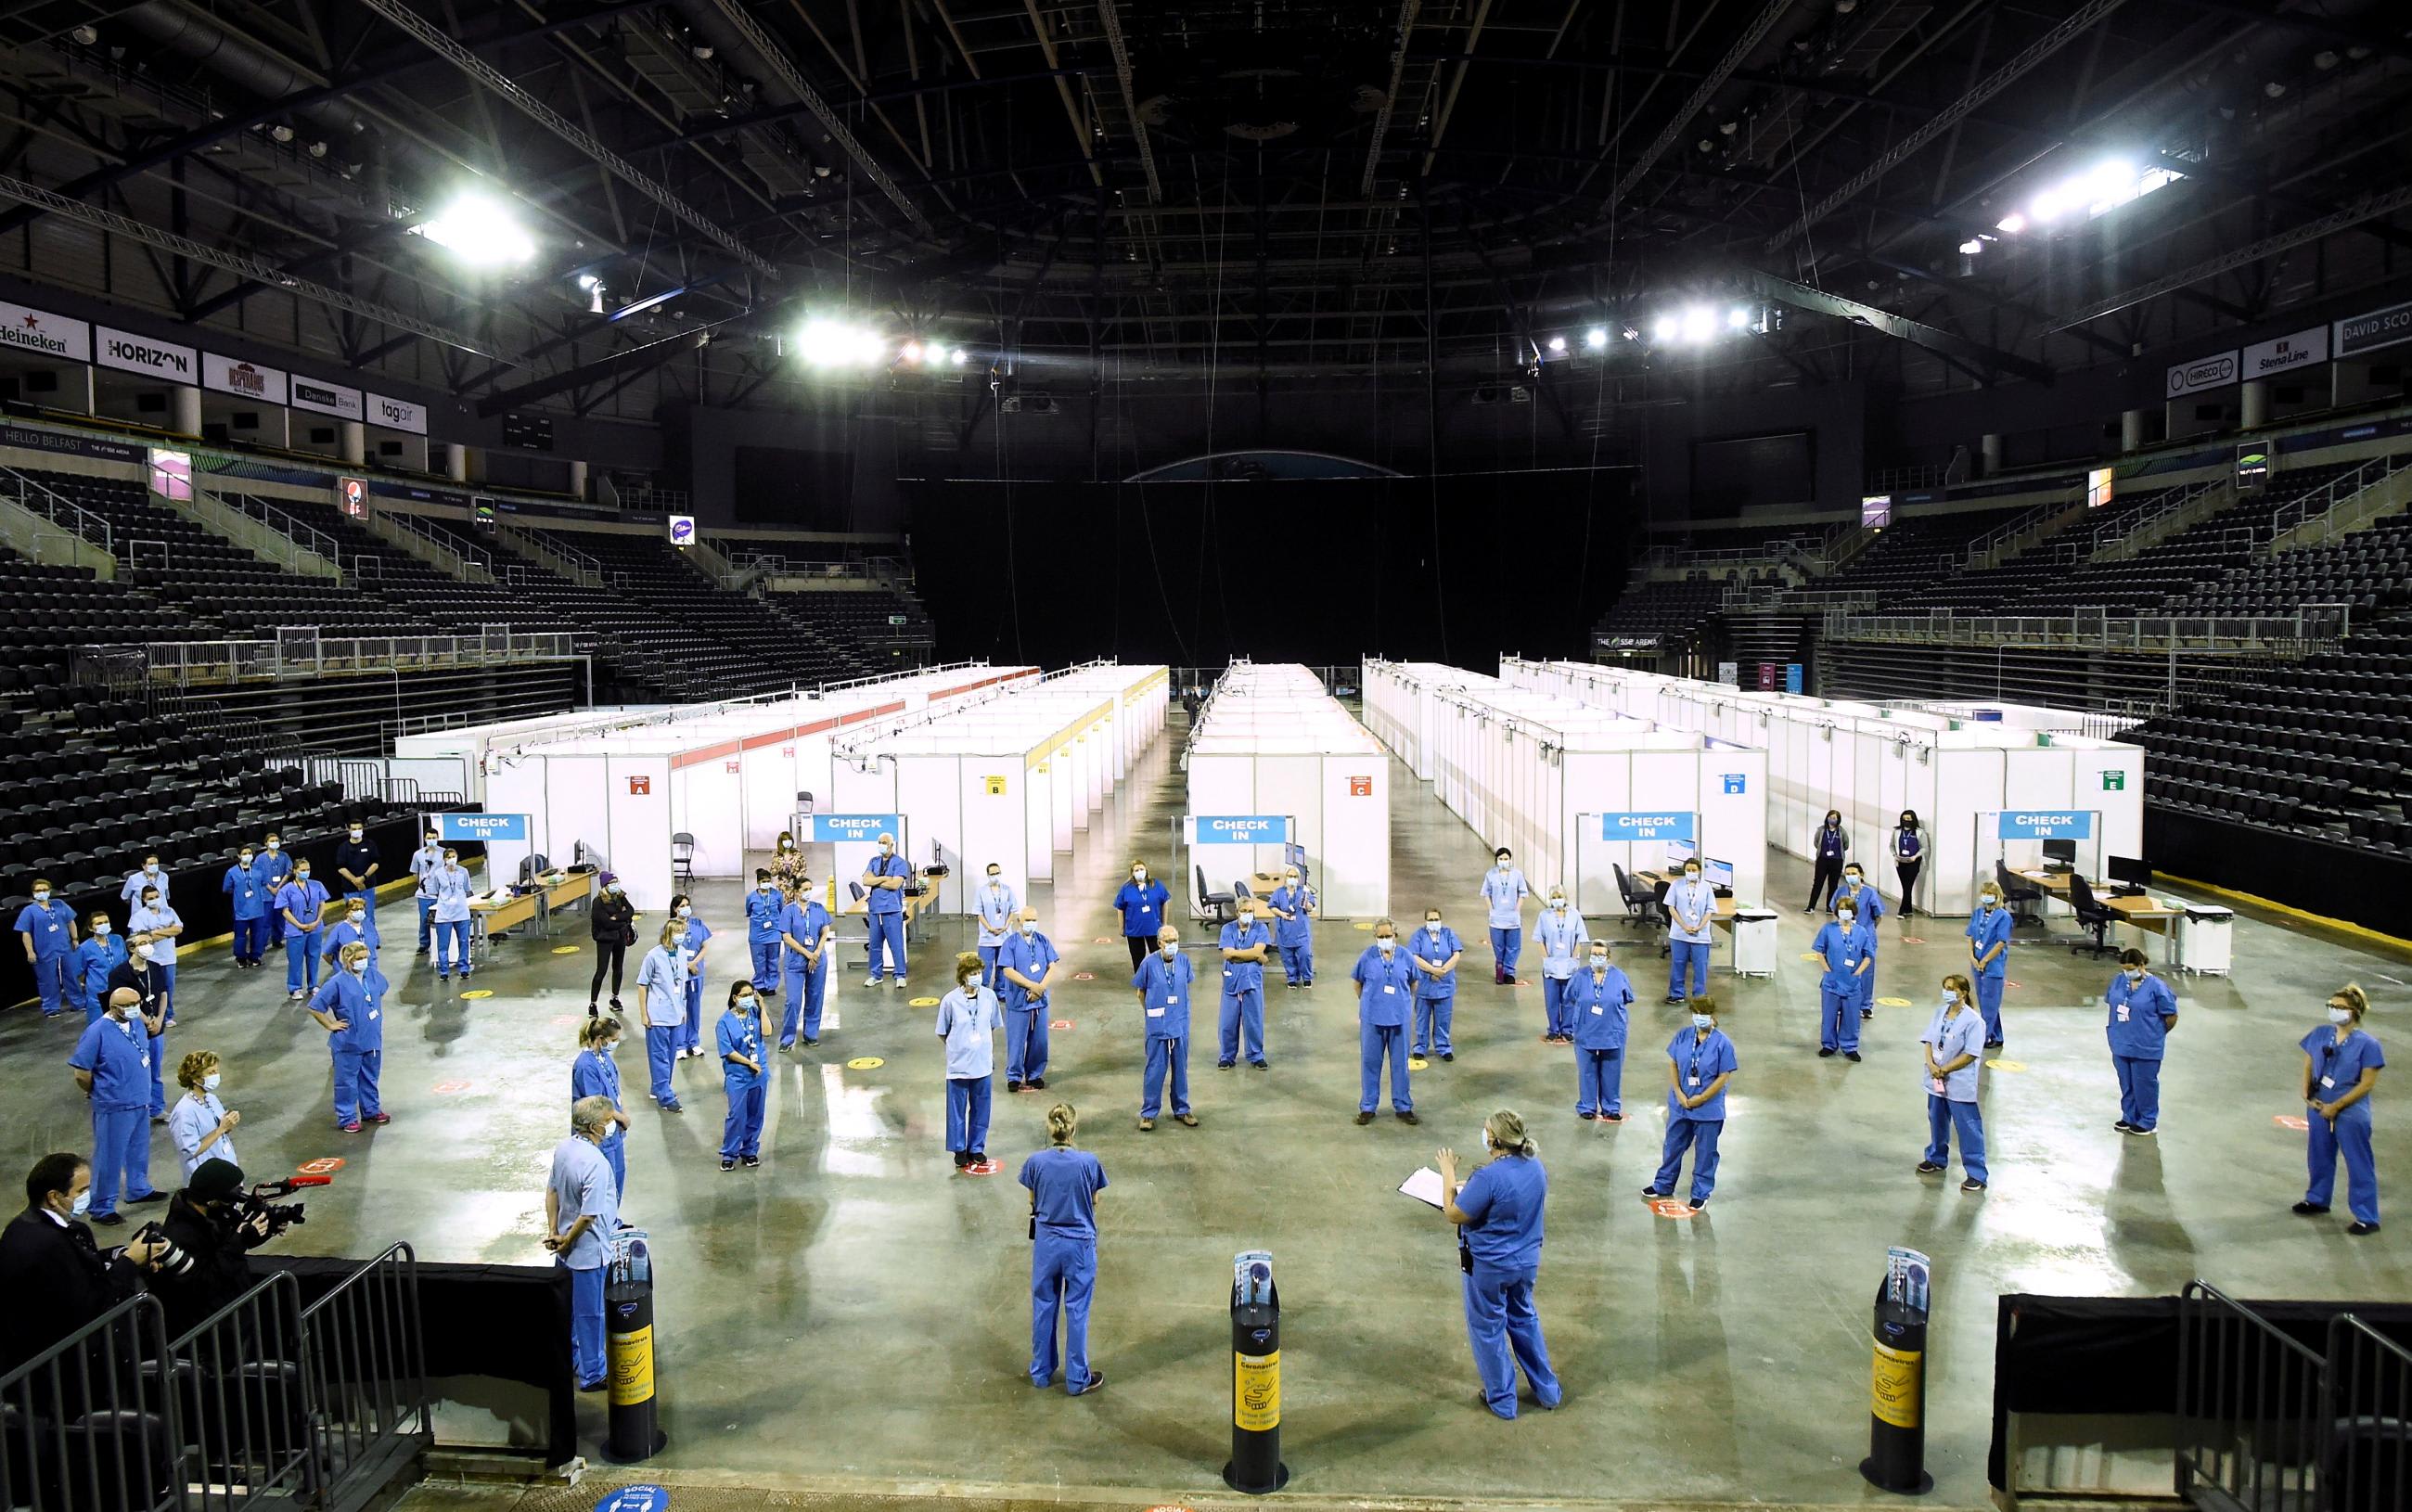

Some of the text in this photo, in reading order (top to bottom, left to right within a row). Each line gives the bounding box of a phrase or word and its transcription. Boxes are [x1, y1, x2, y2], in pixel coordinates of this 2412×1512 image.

[2343, 311, 2412, 340] DAVID SCO
[2259, 349, 2309, 371] Stena Line
[304, 389, 357, 410] Danske Bank
[381, 400, 414, 423] tagair
[6, 429, 83, 451] HELLO BELFAST
[635, 786, 644, 795] A
[992, 786, 999, 794] B
[1730, 785, 1738, 793] D
[2109, 781, 2117, 790] E
[1356, 787, 1366, 796] C
[457, 817, 509, 827] CHECK
[828, 818, 882, 828] CHECK
[1618, 816, 1675, 826] CHECK
[2015, 814, 2072, 825] CHECK
[1212, 820, 1269, 830] CHECK
[476, 828, 492, 838] IN
[847, 829, 864, 839] IN
[1232, 831, 1250, 840] IN
[1638, 827, 1656, 838] IN
[2034, 826, 2052, 836] IN
[609, 1335, 648, 1347] ronavirus
[624, 1485, 657, 1493] SOCIAL
